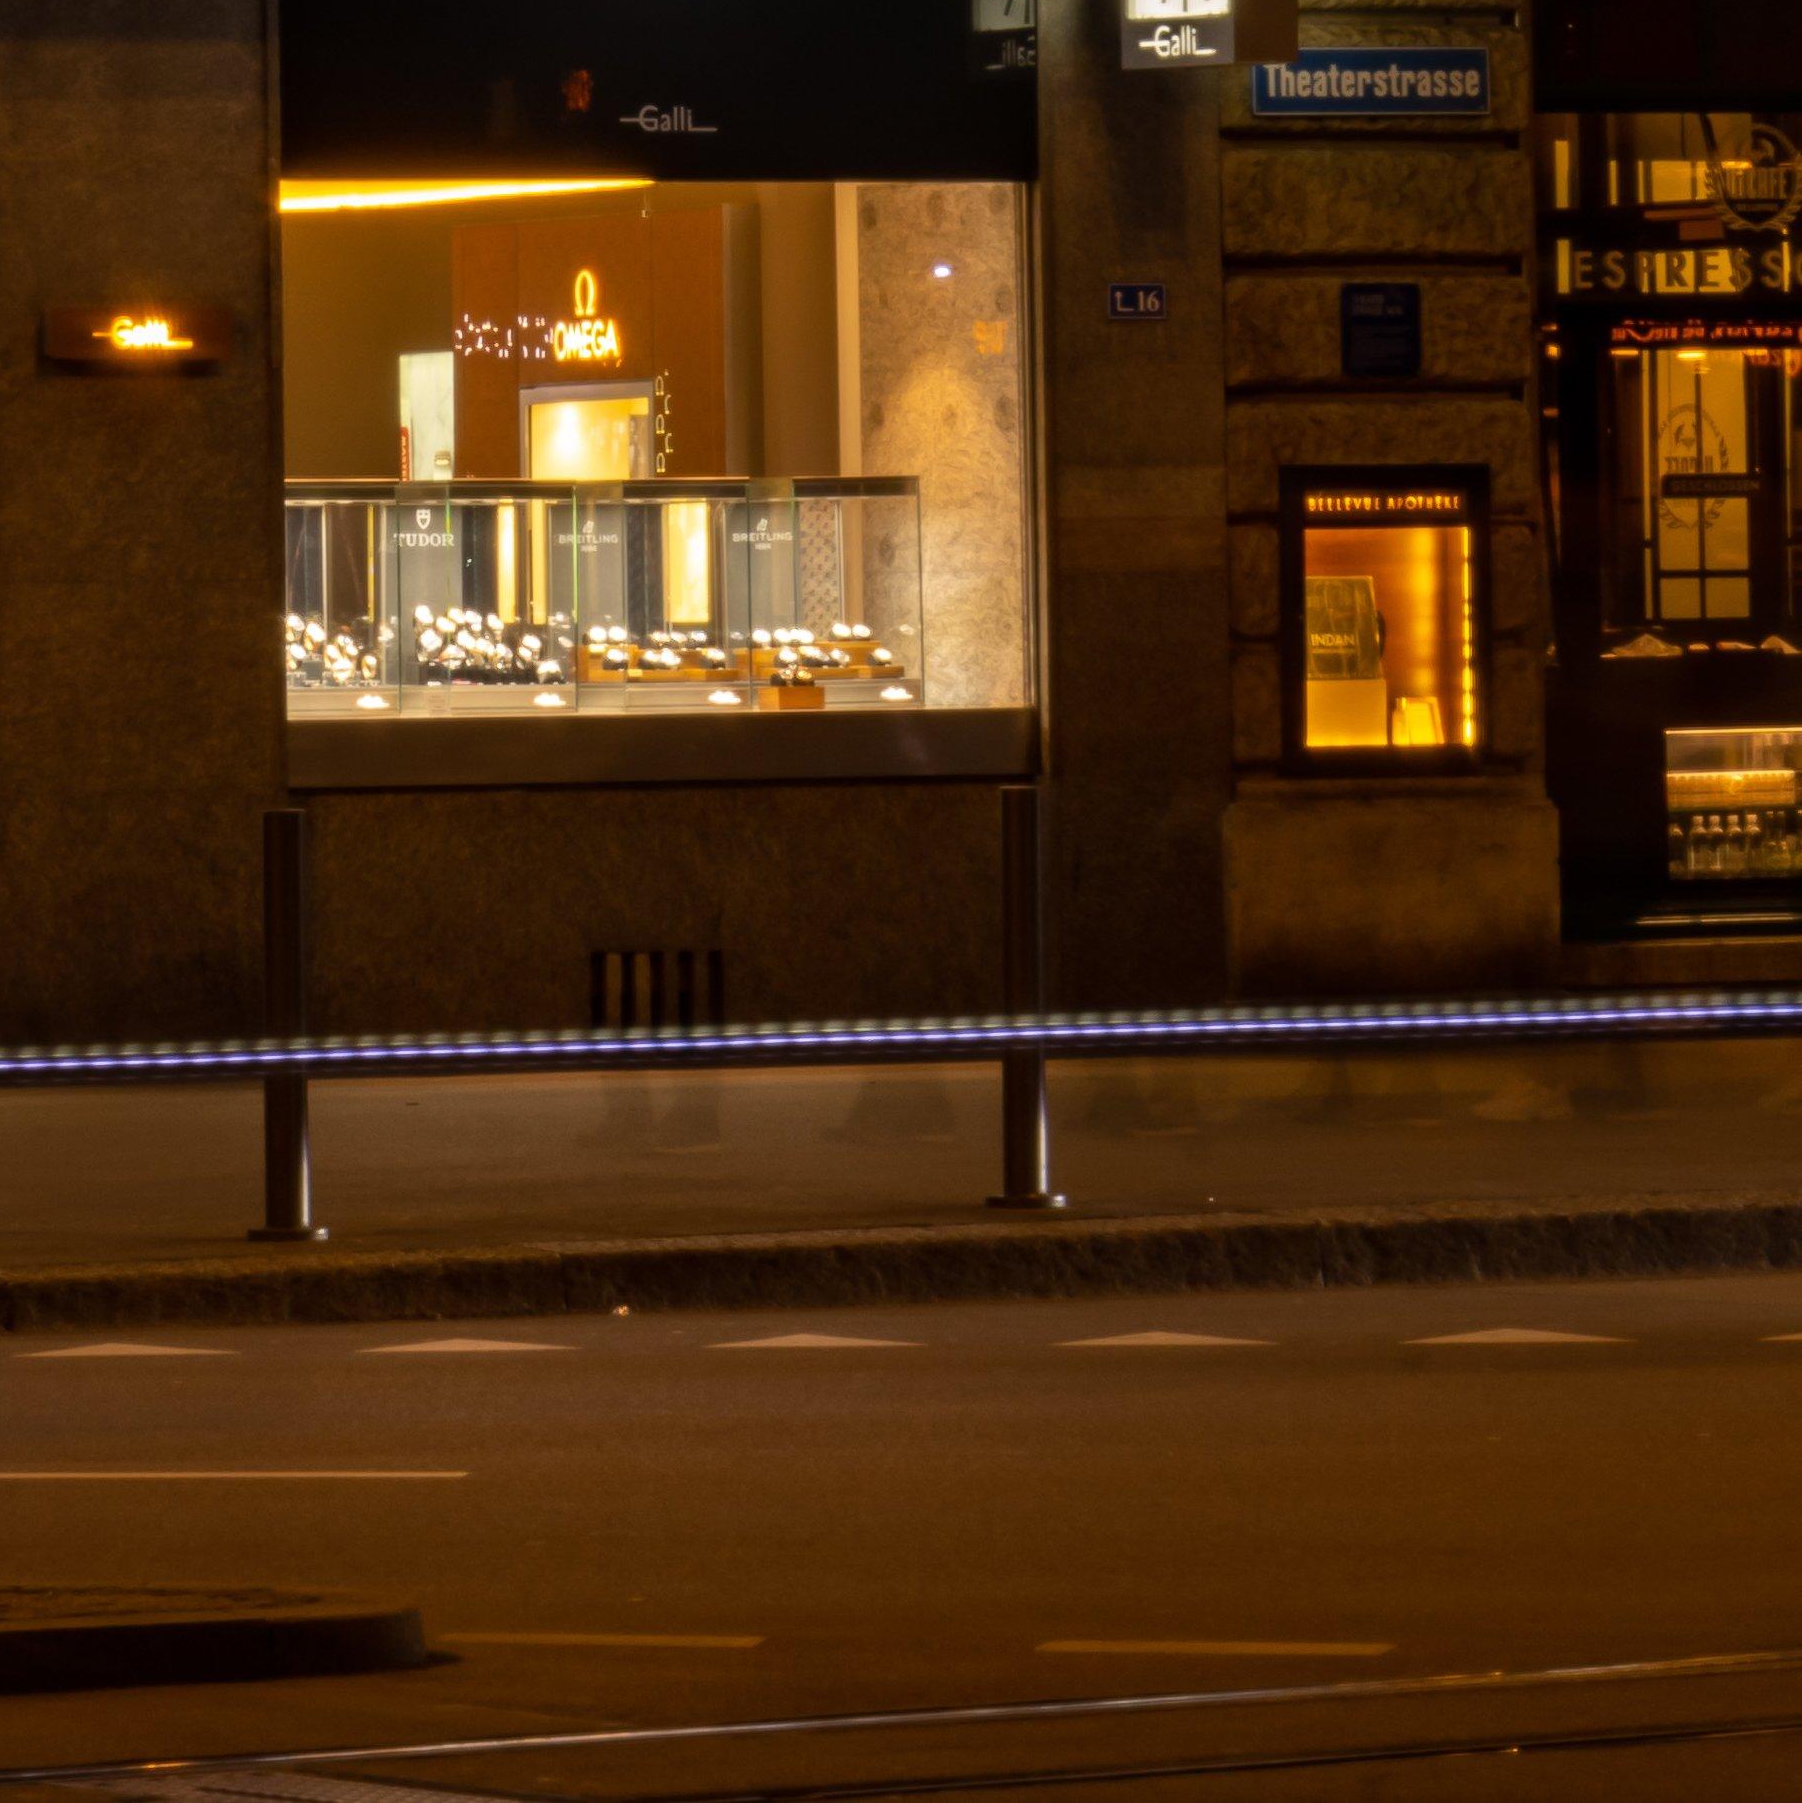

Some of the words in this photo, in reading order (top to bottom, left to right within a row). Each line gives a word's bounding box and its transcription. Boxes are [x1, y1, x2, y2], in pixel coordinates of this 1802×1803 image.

[1138, 24, 1217, 58] Galli
[1263, 62, 1481, 98] Theaterstrasse
[619, 104, 719, 133] Galli
[1573, 249, 1802, 291] ESPRESS
[1137, 290, 1161, 312] 16
[553, 319, 621, 361] OMEGA
[393, 533, 455, 548] TUDOR
[731, 532, 793, 543] BREITLING
